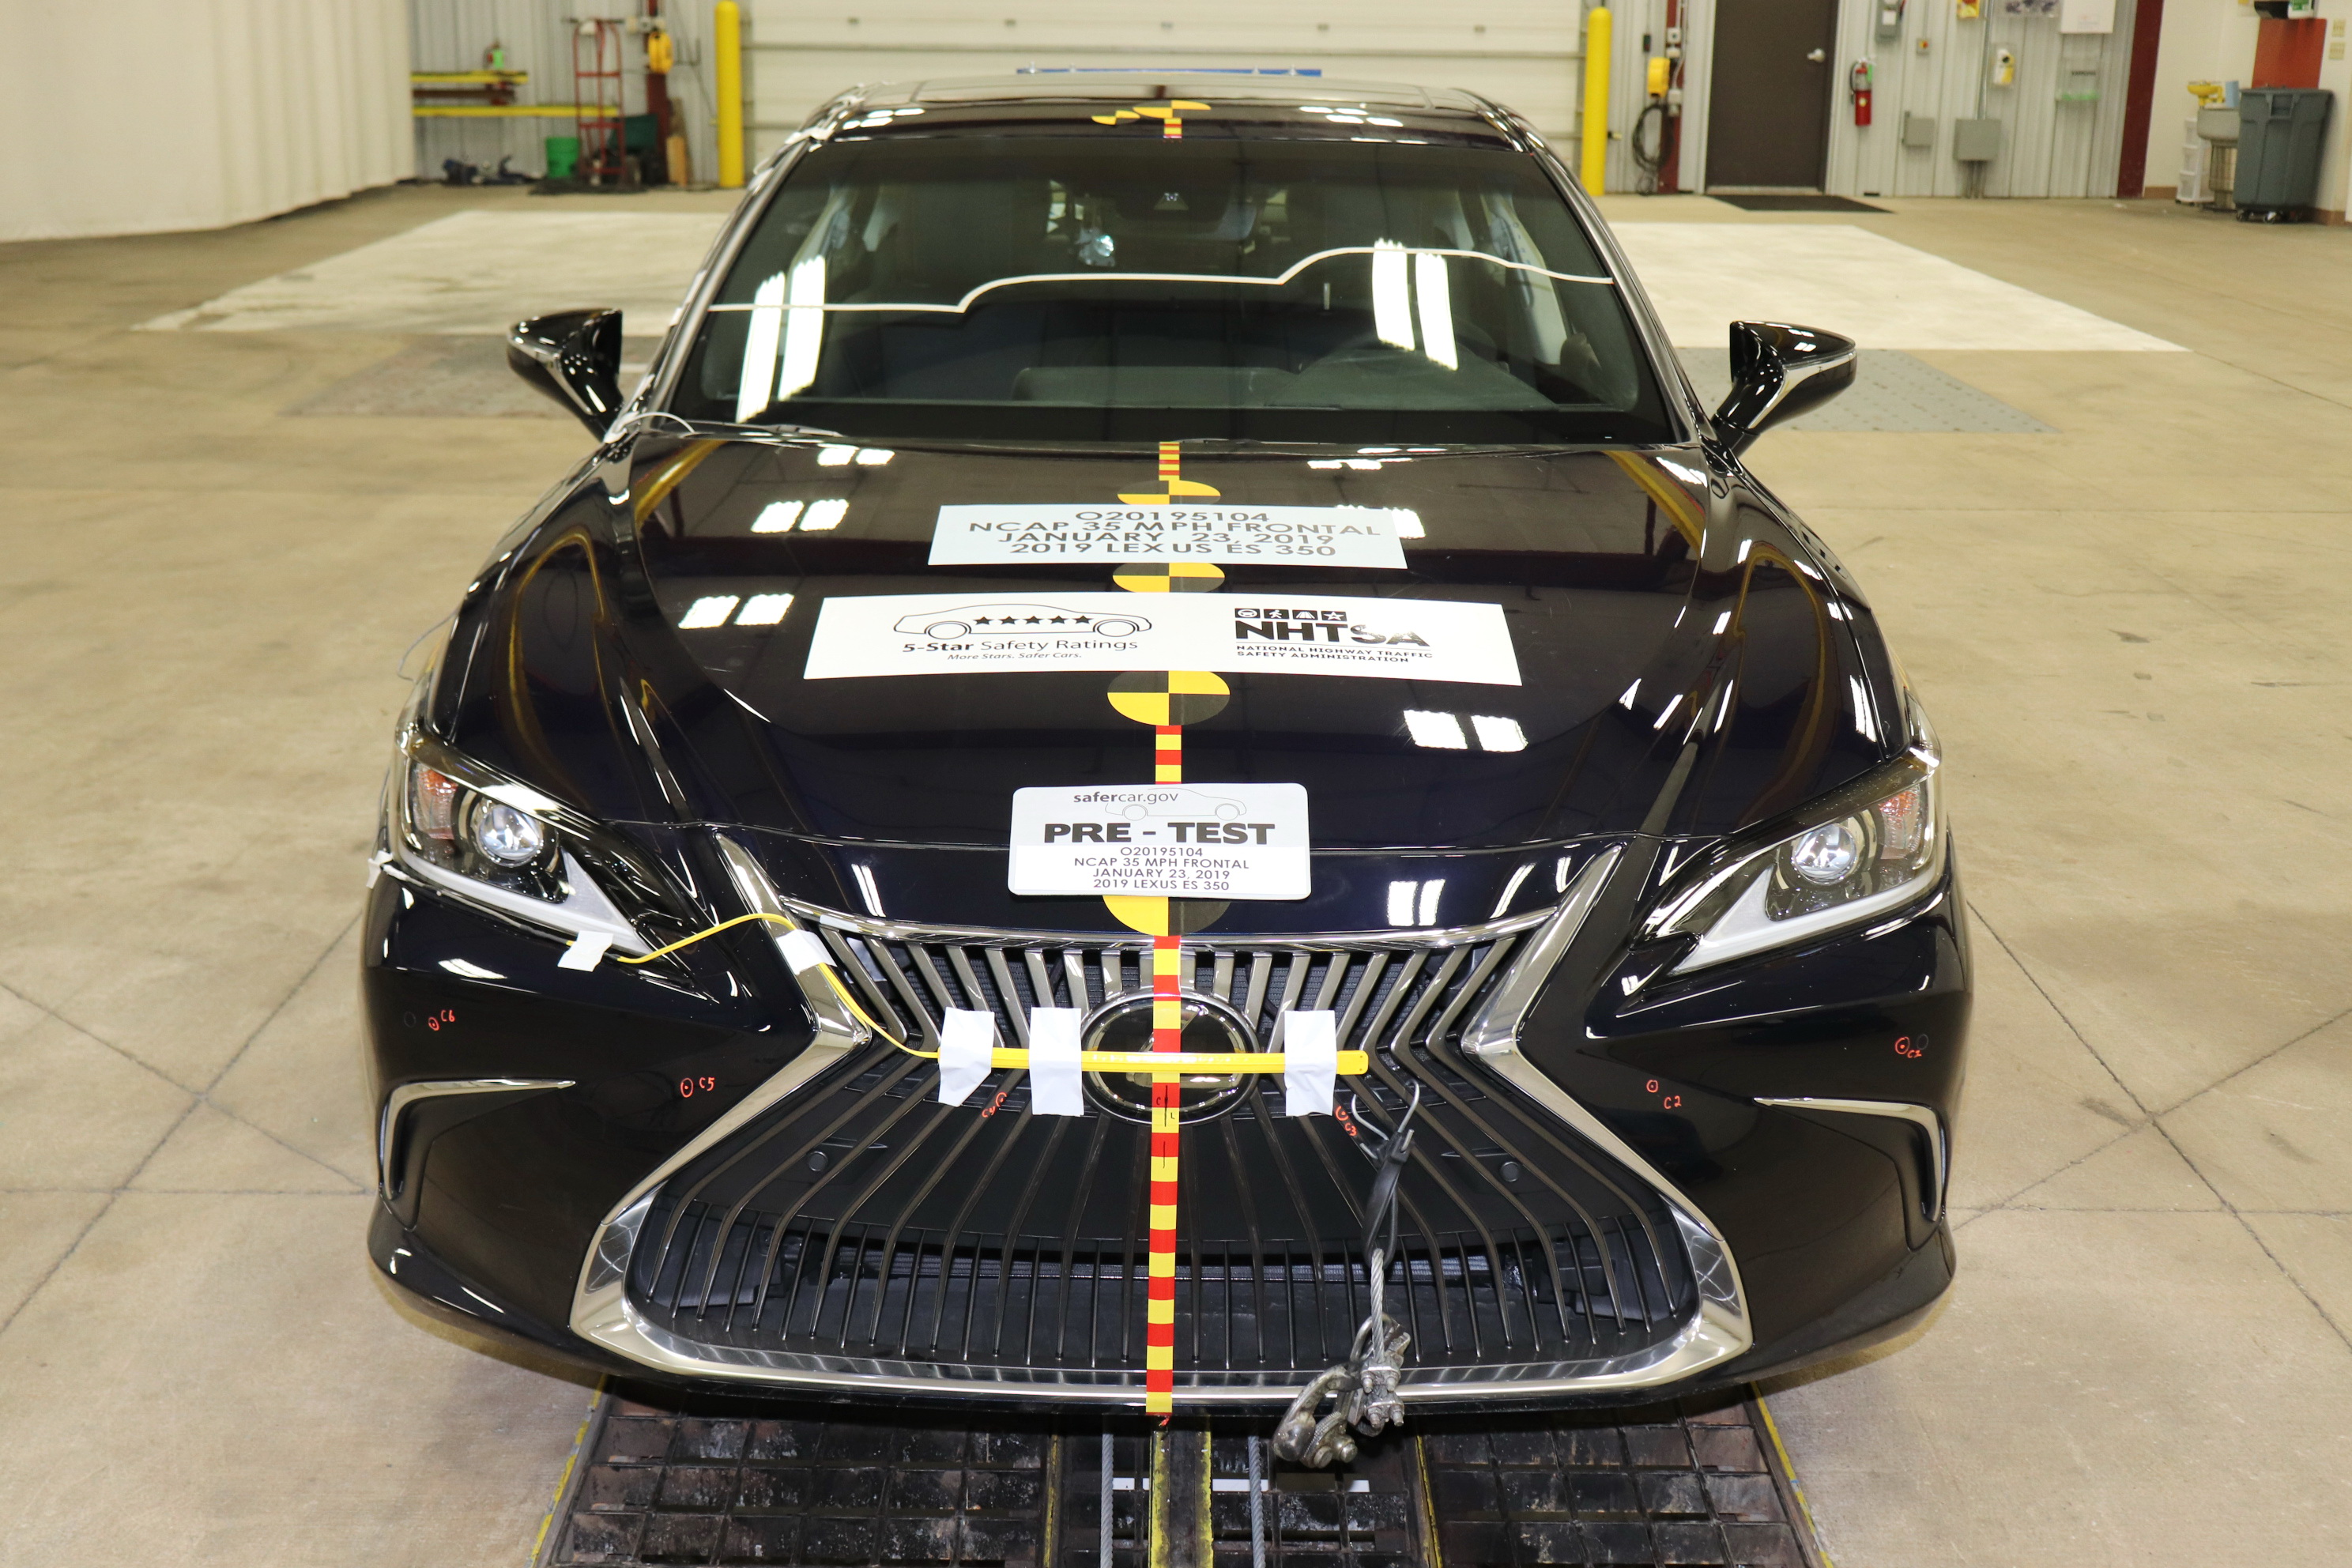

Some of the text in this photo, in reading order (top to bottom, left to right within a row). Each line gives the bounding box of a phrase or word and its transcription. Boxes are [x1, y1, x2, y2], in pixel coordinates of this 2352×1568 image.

[970, 522, 1381, 536] NCAP 35 MPH FRONTAL
[998, 533, 1334, 545] JANUARY 23, 2019
[1010, 543, 1336, 556] 2019 LEXUS ES 350
[1235, 620, 1430, 646] NHTSA
[903, 640, 1138, 652] 5-Star Safety Ratings
[1291, 653, 1408, 662] ADMINISTRATION
[1073, 791, 1178, 805] safercar.gov
[1044, 823, 1132, 843] PRE
[1167, 822, 1276, 845] TEST
[1074, 858, 1250, 869] NCAP 35 MPH FRONTAL
[1093, 869, 1230, 880] JANUARY 23, 2019
[1093, 879, 1230, 891] 2019 LEXUS ES 350
[699, 1076, 715, 1091] C5
[1664, 1095, 1682, 1110] C2
[1344, 1122, 1357, 1136] C3
